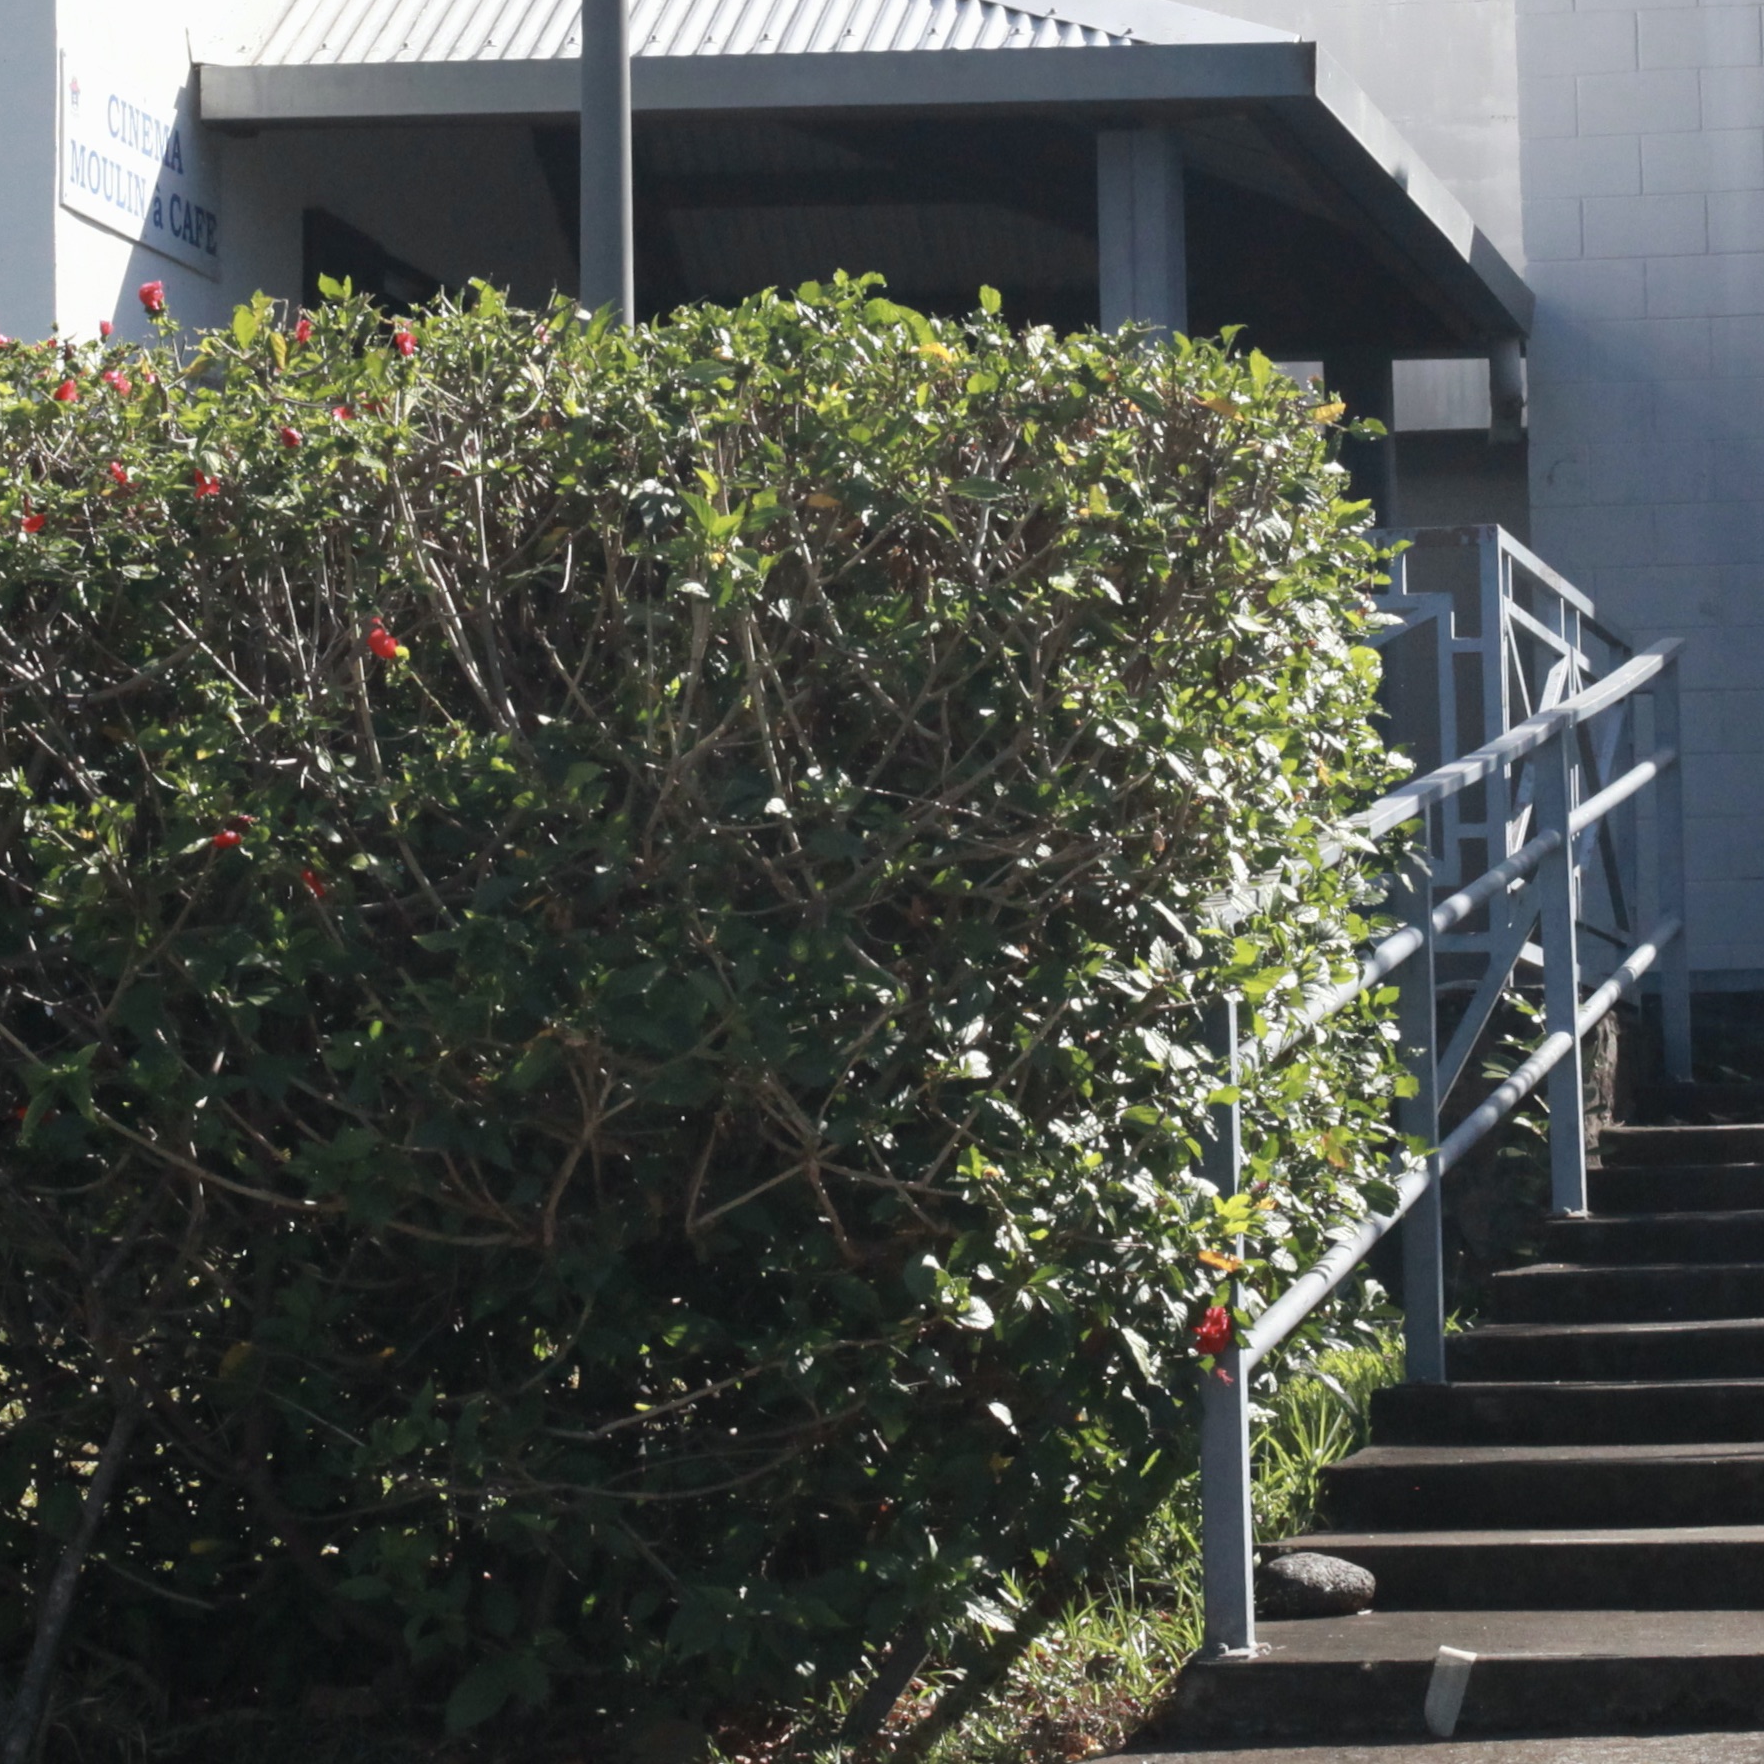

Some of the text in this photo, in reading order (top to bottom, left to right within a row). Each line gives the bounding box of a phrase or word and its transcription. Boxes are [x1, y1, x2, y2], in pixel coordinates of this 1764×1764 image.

[107, 95, 183, 174] CINEMA
[70, 140, 147, 220] MOULIN
[153, 185, 163, 230] à
